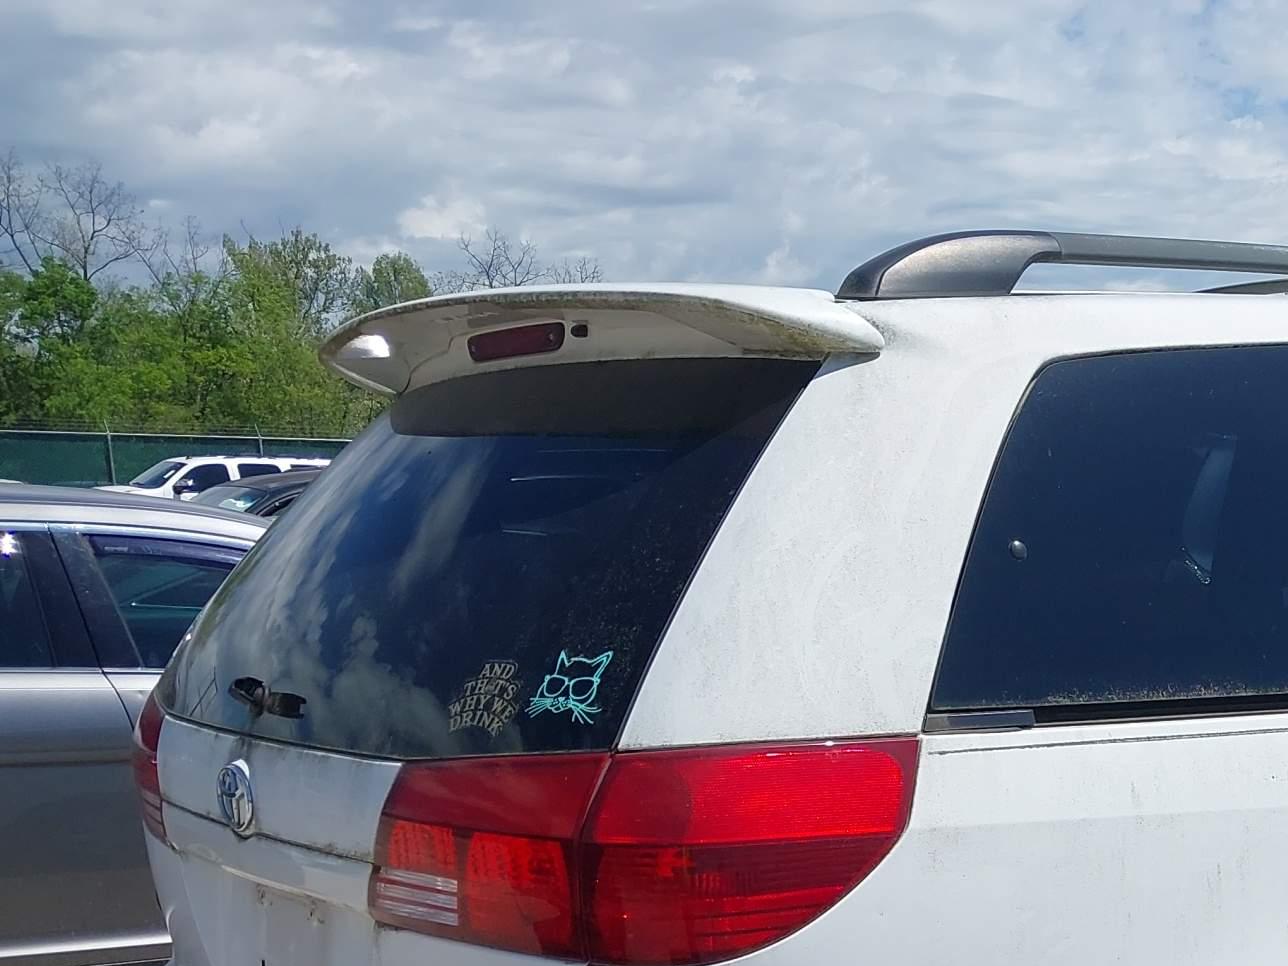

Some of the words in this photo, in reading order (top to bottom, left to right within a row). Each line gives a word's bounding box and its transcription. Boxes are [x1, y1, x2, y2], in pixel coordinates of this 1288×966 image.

[480, 663, 515, 680] AND
[448, 695, 492, 717] WHY
[491, 696, 515, 722] WE
[449, 710, 503, 737] DRINK
